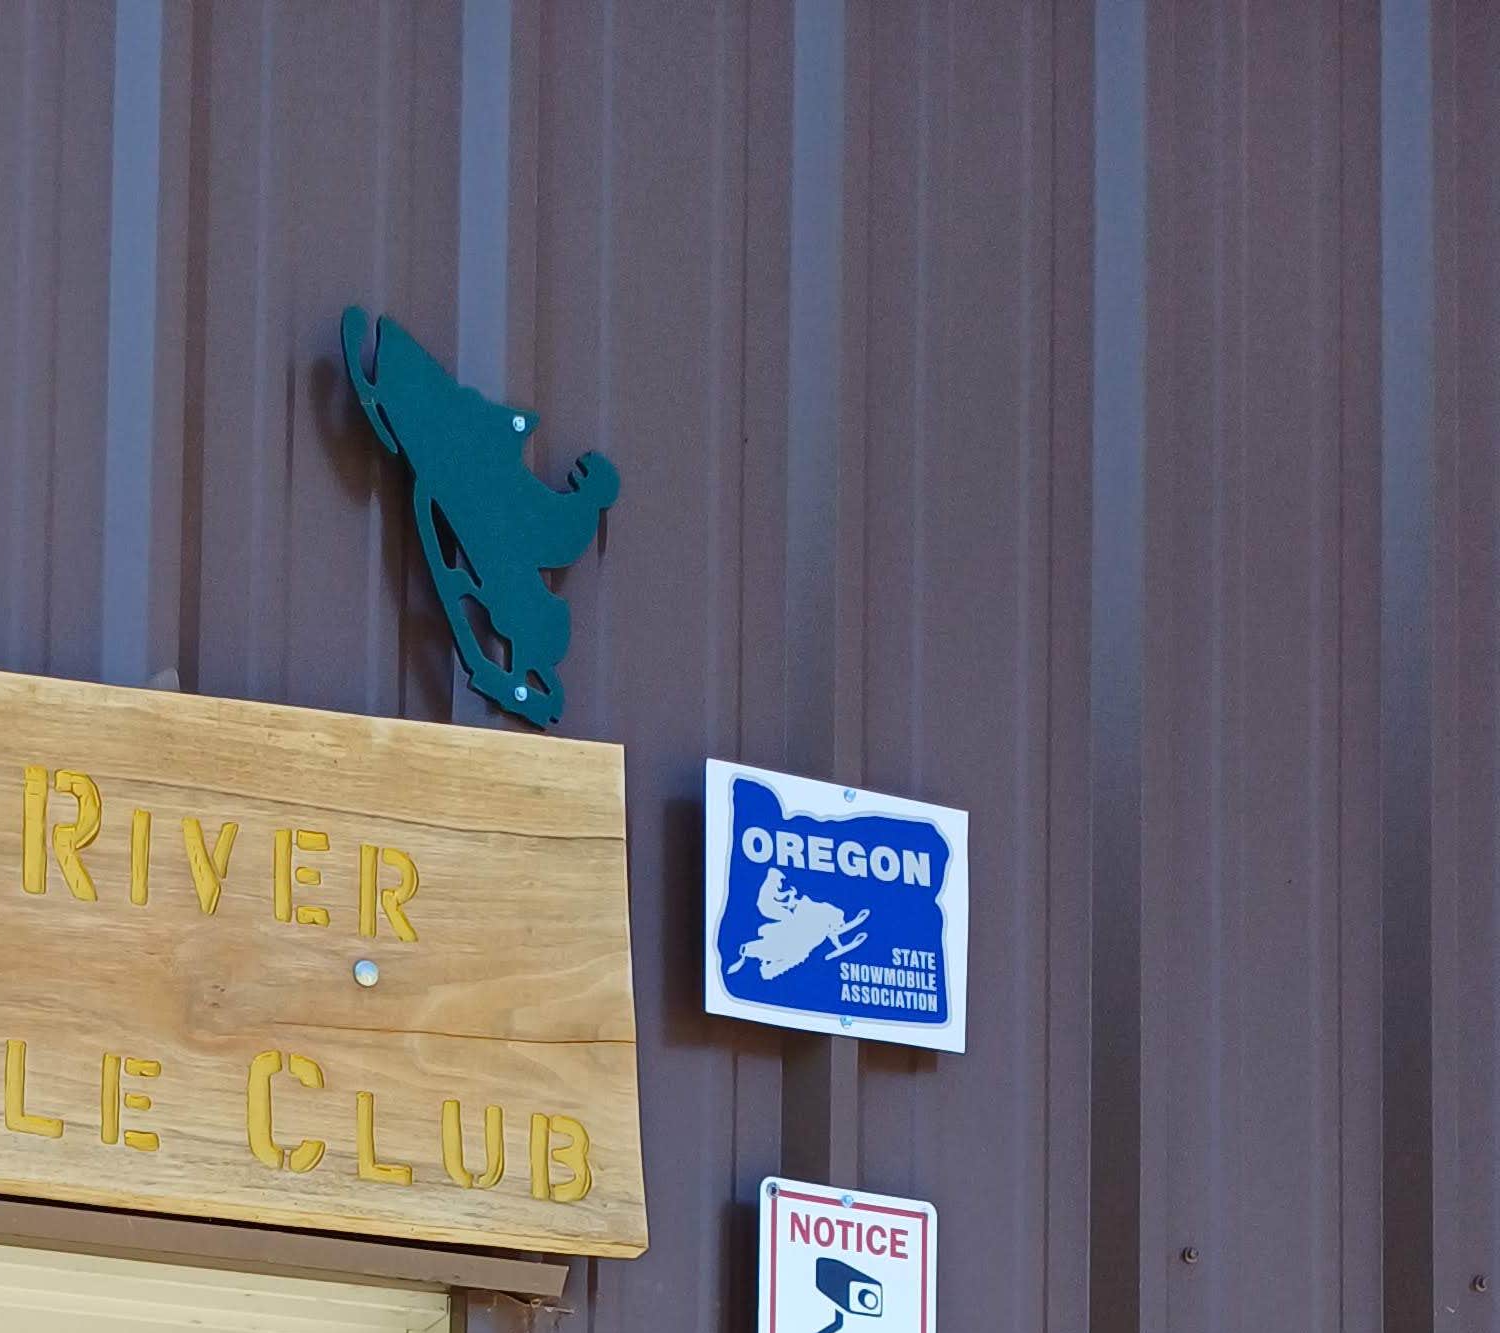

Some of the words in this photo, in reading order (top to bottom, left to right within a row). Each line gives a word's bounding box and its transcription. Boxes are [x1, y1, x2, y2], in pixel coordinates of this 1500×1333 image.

[22, 764, 420, 942] RIVER
[742, 826, 930, 886] OREGON
[840, 962, 936, 990] SNOWMOBILE
[892, 947, 935, 969] STATE
[841, 983, 936, 1011] ASSOCIATION
[246, 1049, 593, 1202] CLUB
[790, 1211, 907, 1258] NOTICE
